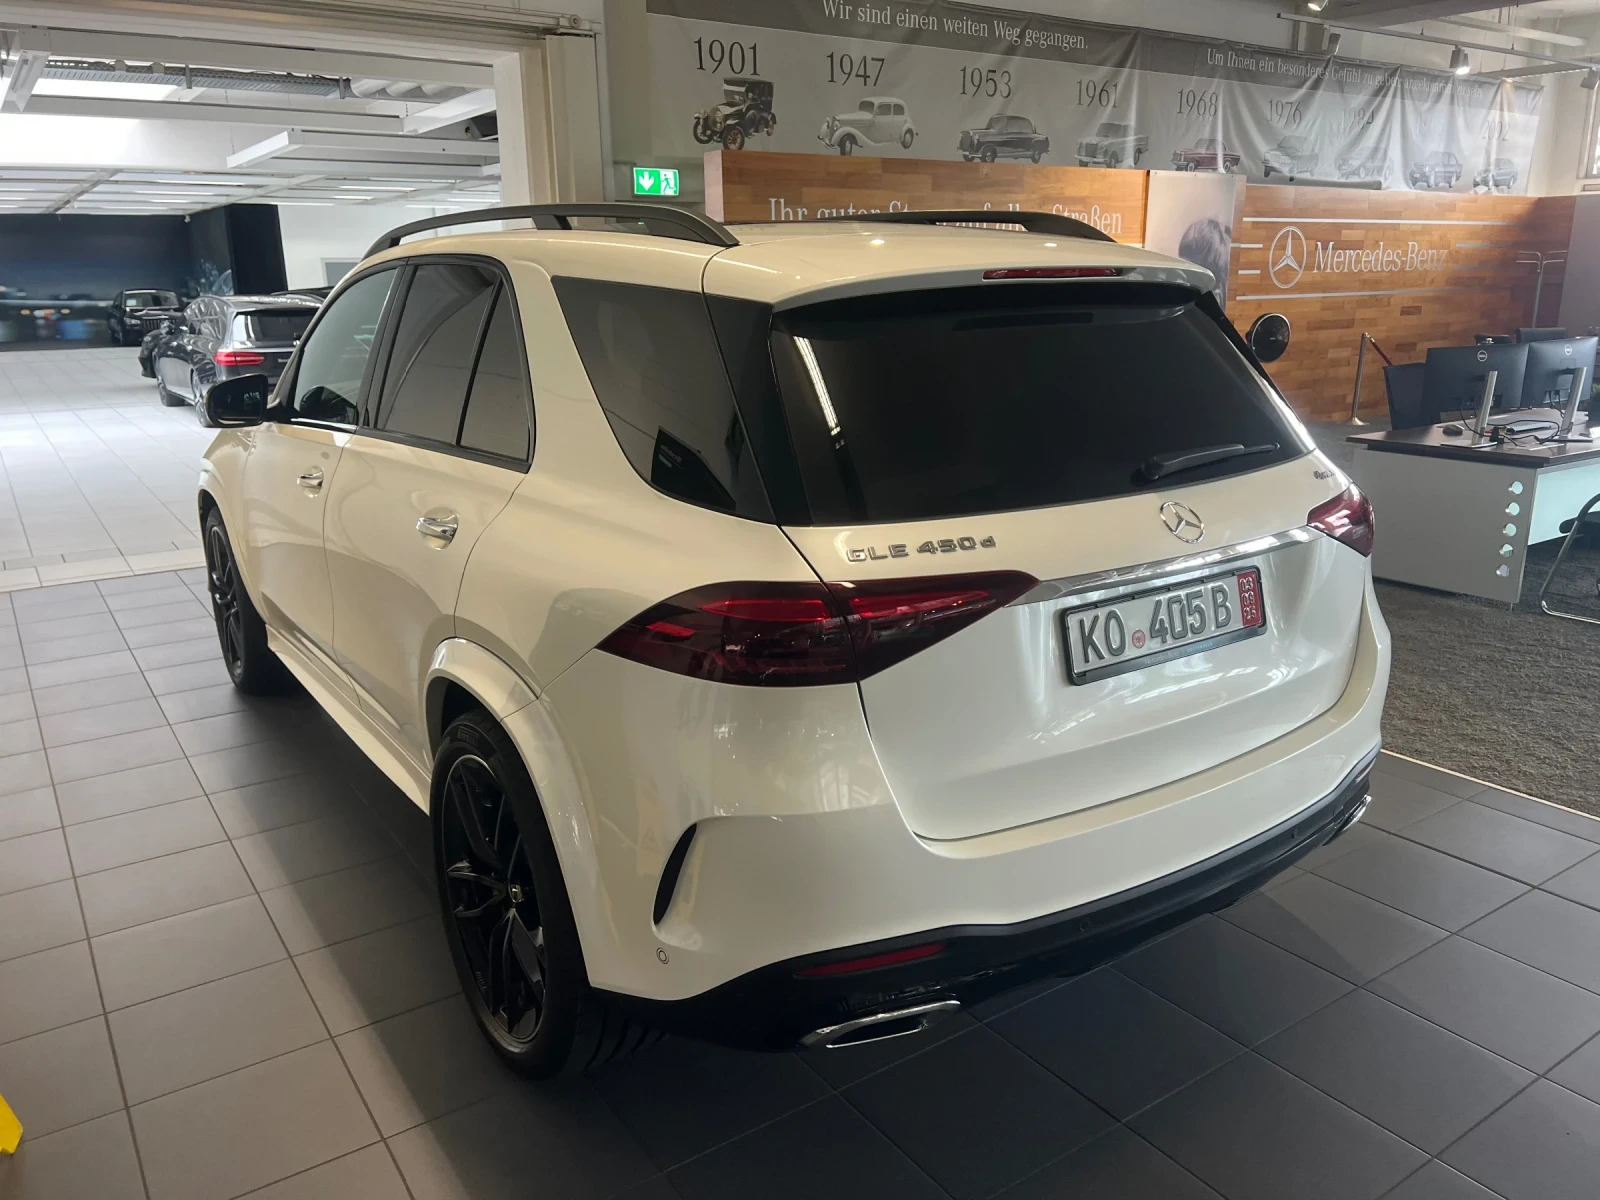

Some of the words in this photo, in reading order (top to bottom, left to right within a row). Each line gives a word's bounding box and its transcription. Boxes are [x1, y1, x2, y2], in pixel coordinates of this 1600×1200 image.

[822, 0, 853, 20] Wir
[857, 4, 891, 25] sind
[896, 9, 938, 31] einen
[943, 16, 989, 38] weiten
[993, 20, 1021, 46] Weg
[1025, 29, 1089, 52] gegangen.
[694, 37, 761, 77] 1901
[826, 51, 885, 87] 1947
[1207, 48, 1224, 66] Um
[1227, 51, 1256, 71] Ihnen
[1259, 57, 1275, 73] ein
[1278, 59, 1329, 79] besonderes
[1331, 66, 1361, 83] Gefühl
[1363, 73, 1373, 84] zu
[959, 65, 1012, 99] 1953
[1076, 78, 1119, 110] 1961
[1177, 88, 1219, 118] 1968
[1268, 97, 1302, 128] 1976
[1313, 241, 1449, 273] Mercedes-Benz
[847, 543, 911, 563] GLE
[916, 536, 977, 555] 450
[980, 535, 997, 549] d
[1079, 609, 1127, 664] KO
